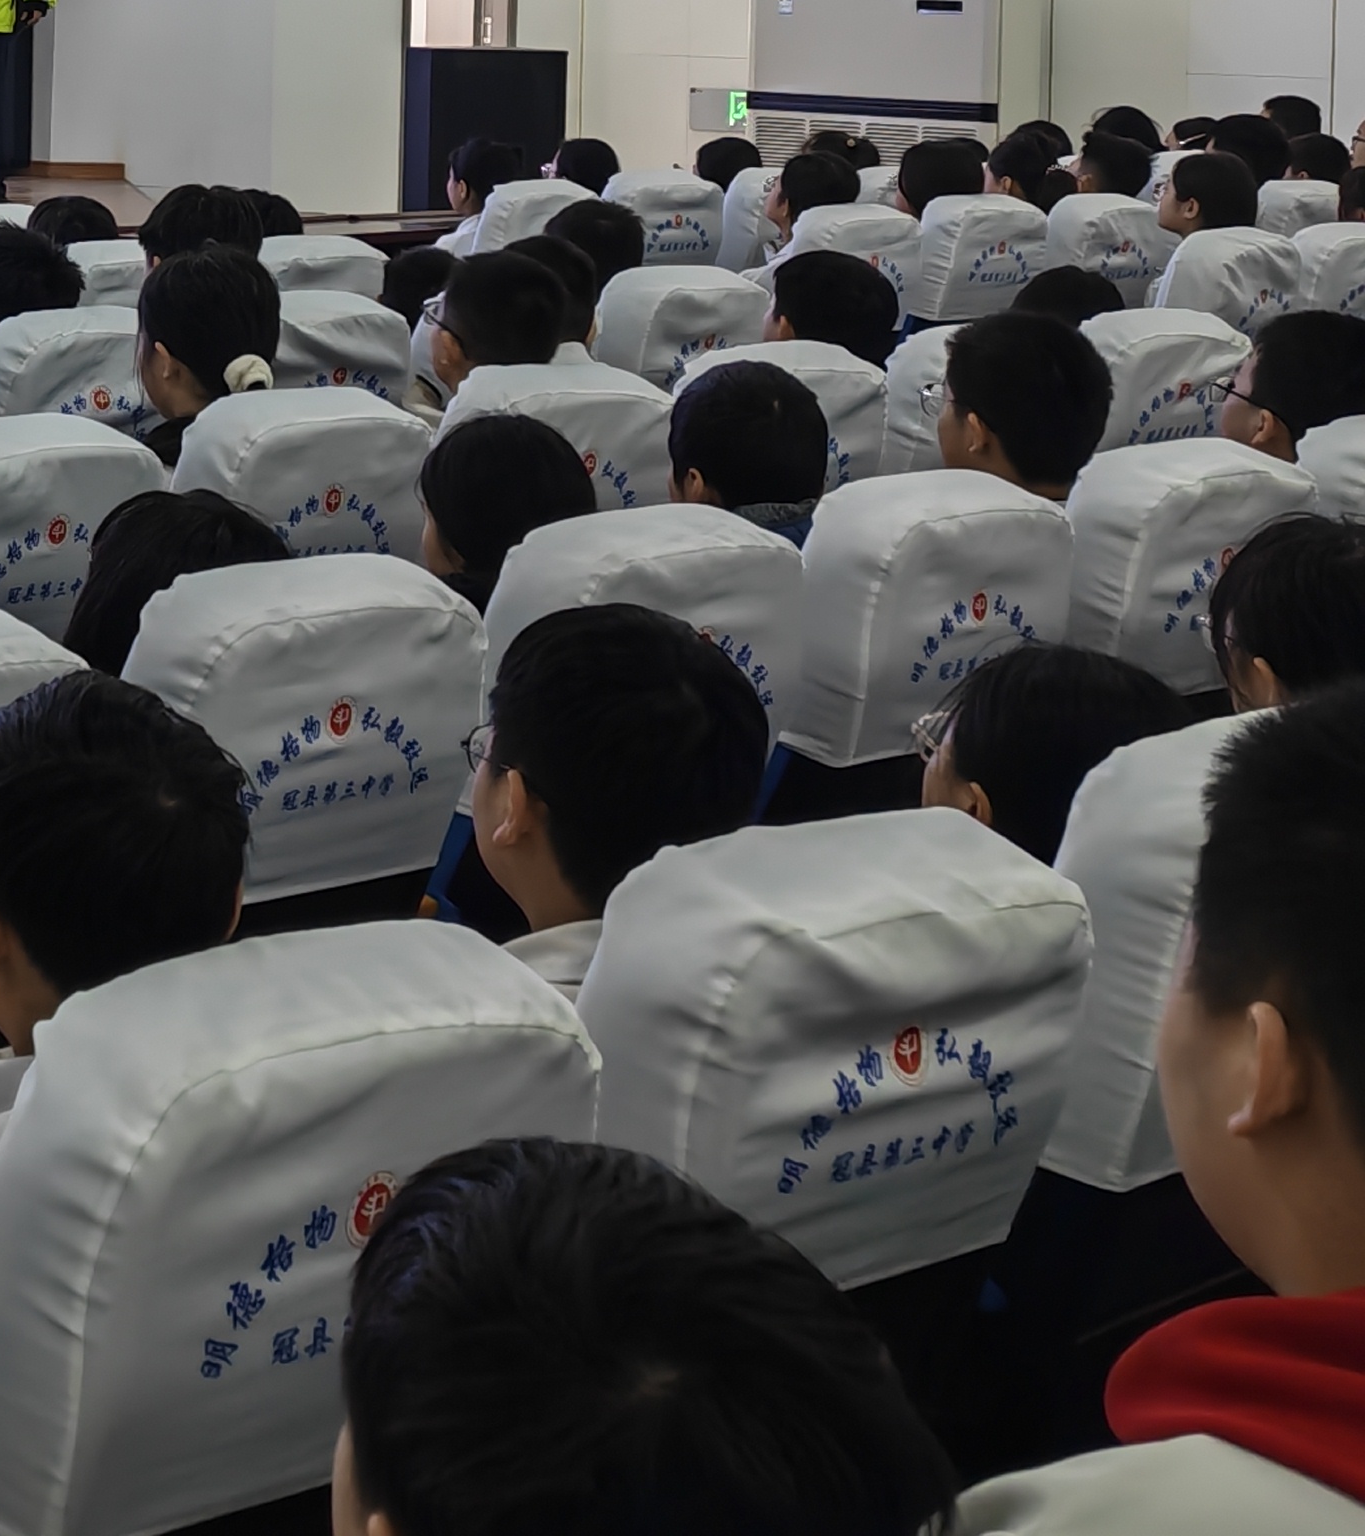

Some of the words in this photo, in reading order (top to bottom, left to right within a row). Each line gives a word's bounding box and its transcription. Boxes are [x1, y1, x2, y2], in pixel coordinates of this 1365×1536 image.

[282, 771, 394, 811] 冠县第三中学
[362, 705, 429, 794] 弘毅致远
[777, 1044, 883, 1194] 明德格物
[200, 1205, 337, 1379] 明德格物
[271, 1317, 350, 1364] 冠县
